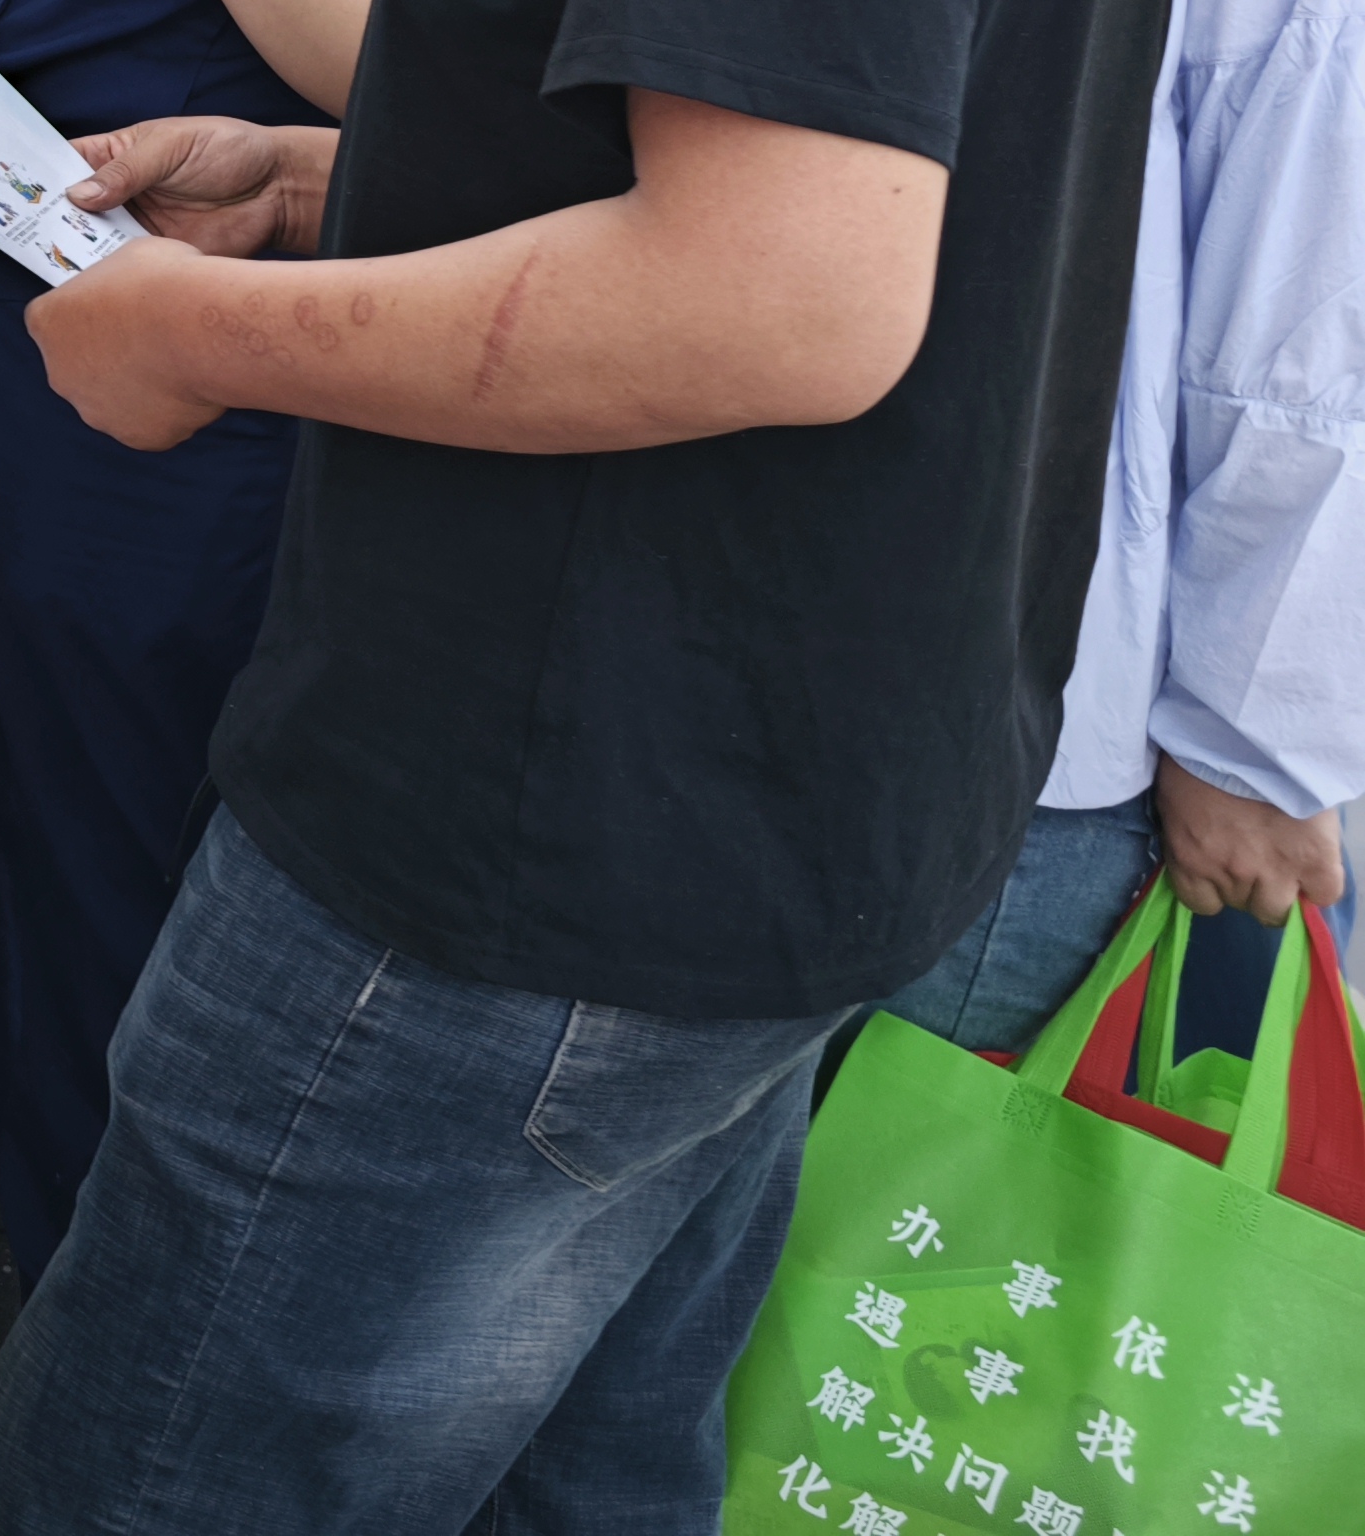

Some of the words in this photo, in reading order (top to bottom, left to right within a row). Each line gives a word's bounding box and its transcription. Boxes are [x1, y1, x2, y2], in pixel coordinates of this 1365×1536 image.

[845, 1281, 1260, 1534] 遇事找法
[887, 1203, 1284, 1437] 办事依法
[777, 1454, 949, 1536] 化解
[807, 1364, 1127, 1536] 解决问题
